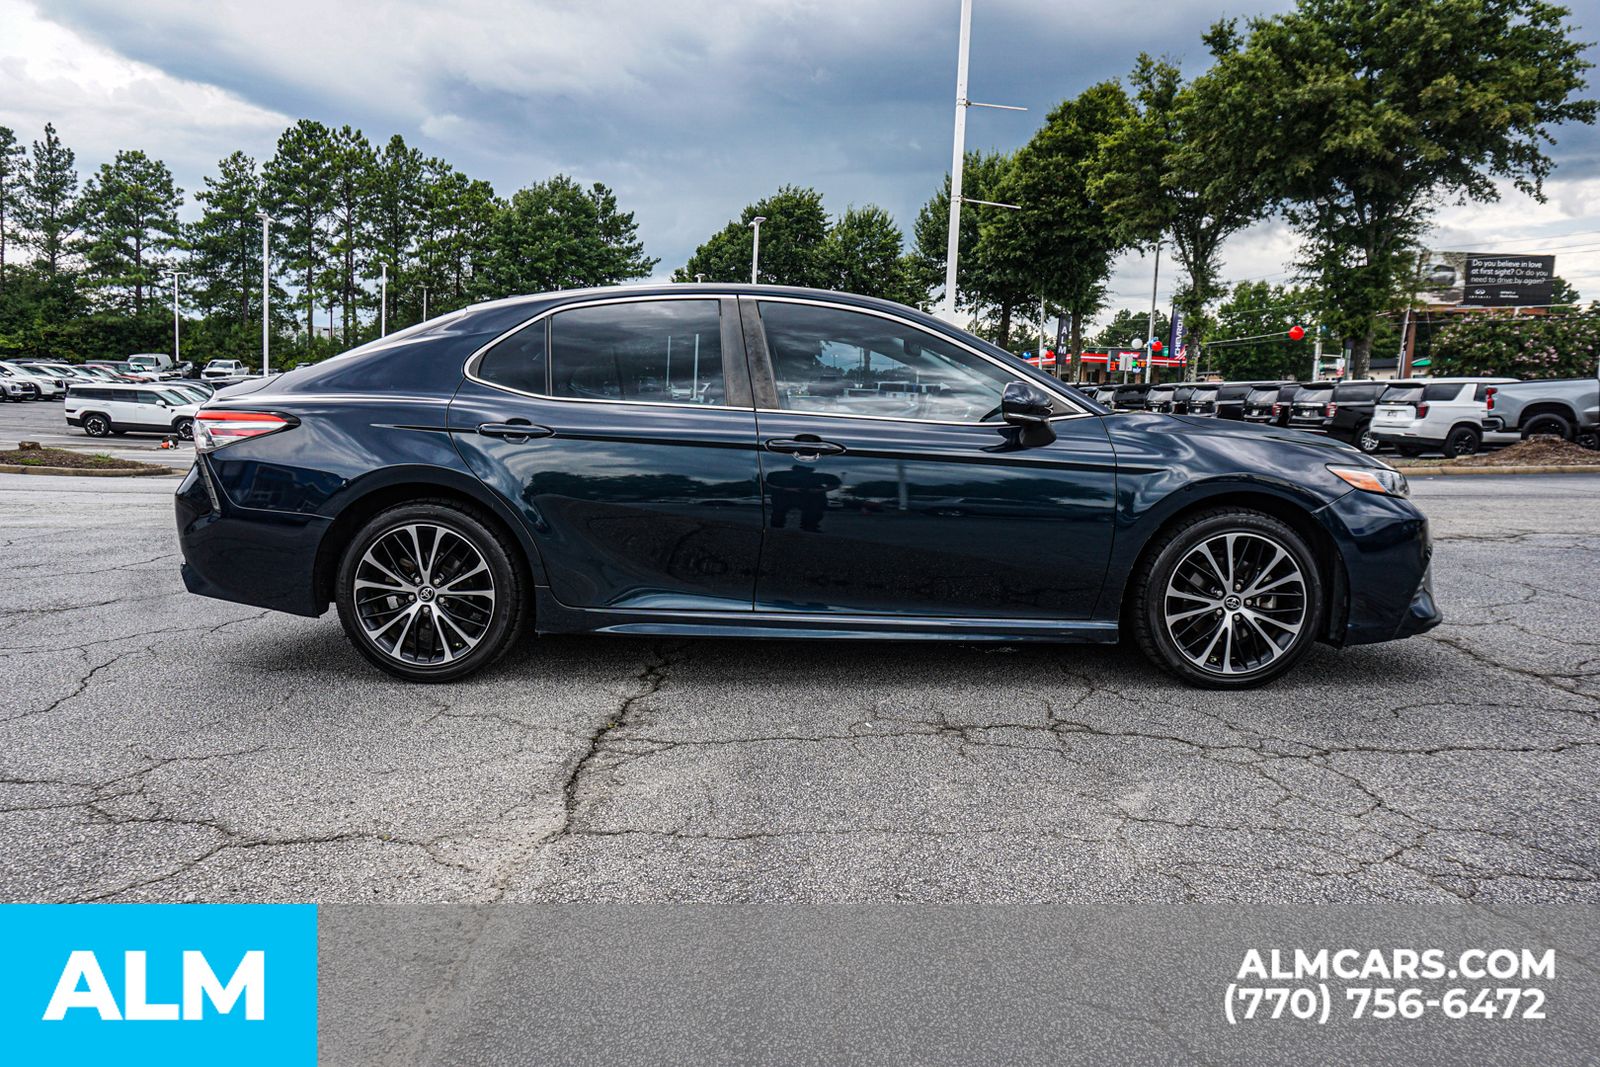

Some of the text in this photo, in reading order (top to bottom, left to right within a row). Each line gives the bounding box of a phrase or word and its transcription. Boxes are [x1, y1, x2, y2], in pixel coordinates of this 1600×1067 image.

[1472, 259, 1483, 267] Do
[1484, 260, 1496, 269] you
[1497, 260, 1520, 268] believe
[1528, 261, 1542, 269] love
[1495, 269, 1515, 277] sight?
[1515, 268, 1524, 276] Or
[1514, 277, 1523, 285] by
[1524, 278, 1546, 286] again?
[1058, 326, 1068, 354] ALM
